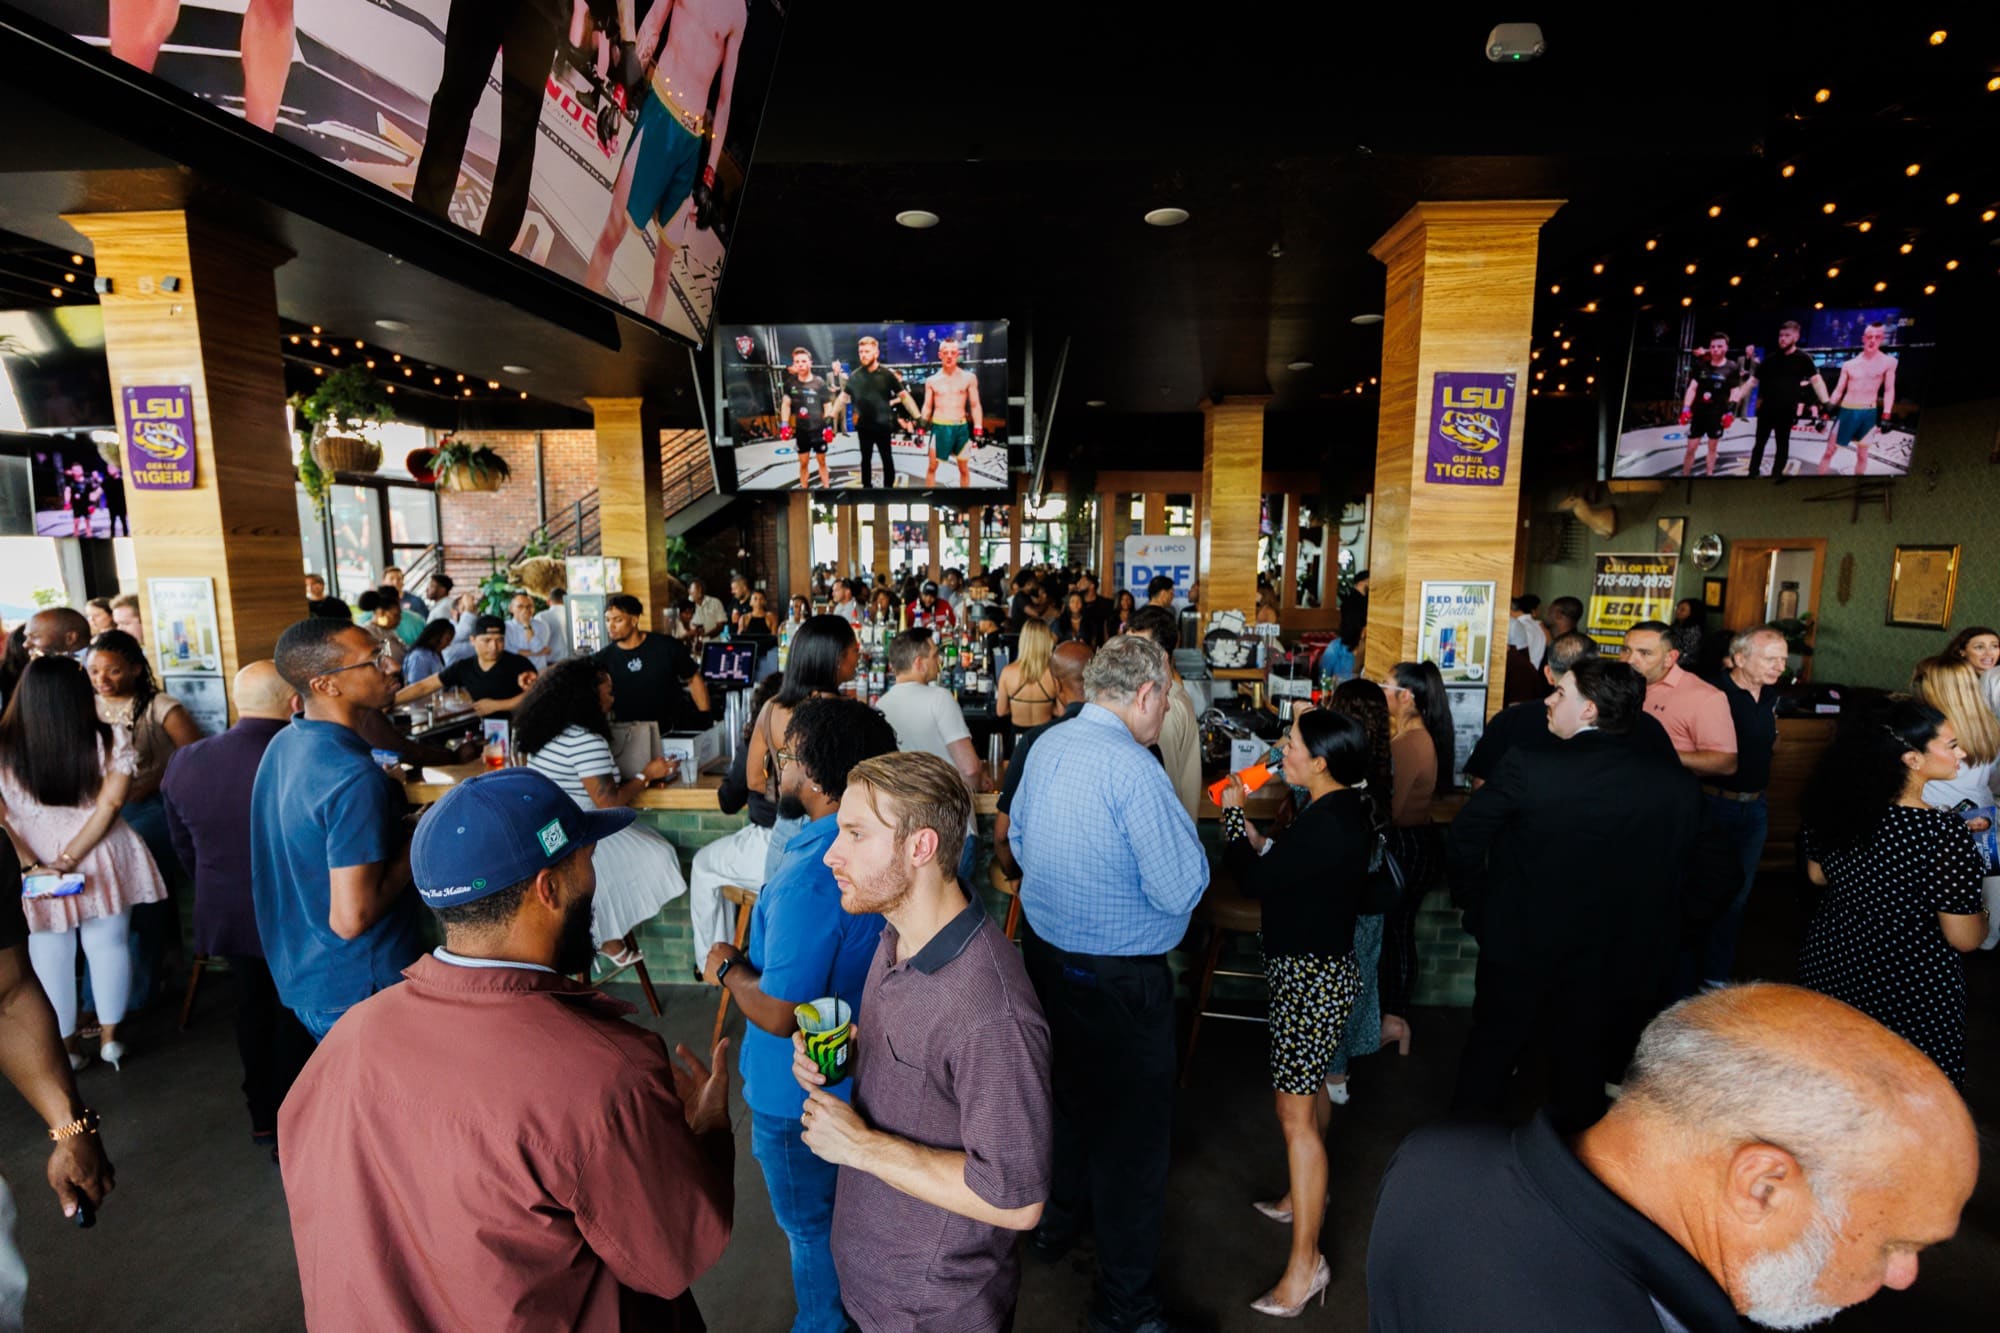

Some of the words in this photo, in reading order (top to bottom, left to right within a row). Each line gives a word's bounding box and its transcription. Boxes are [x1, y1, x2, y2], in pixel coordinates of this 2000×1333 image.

[1443, 387, 1505, 409] LSU
[130, 399, 184, 419] LSU
[133, 471, 191, 484] TIGERS
[1433, 463, 1500, 479] TIGERS
[1131, 565, 1191, 585] DTF
[1628, 564, 1643, 573] OR
[1427, 595, 1451, 604] RED
[1456, 595, 1485, 604] BULL
